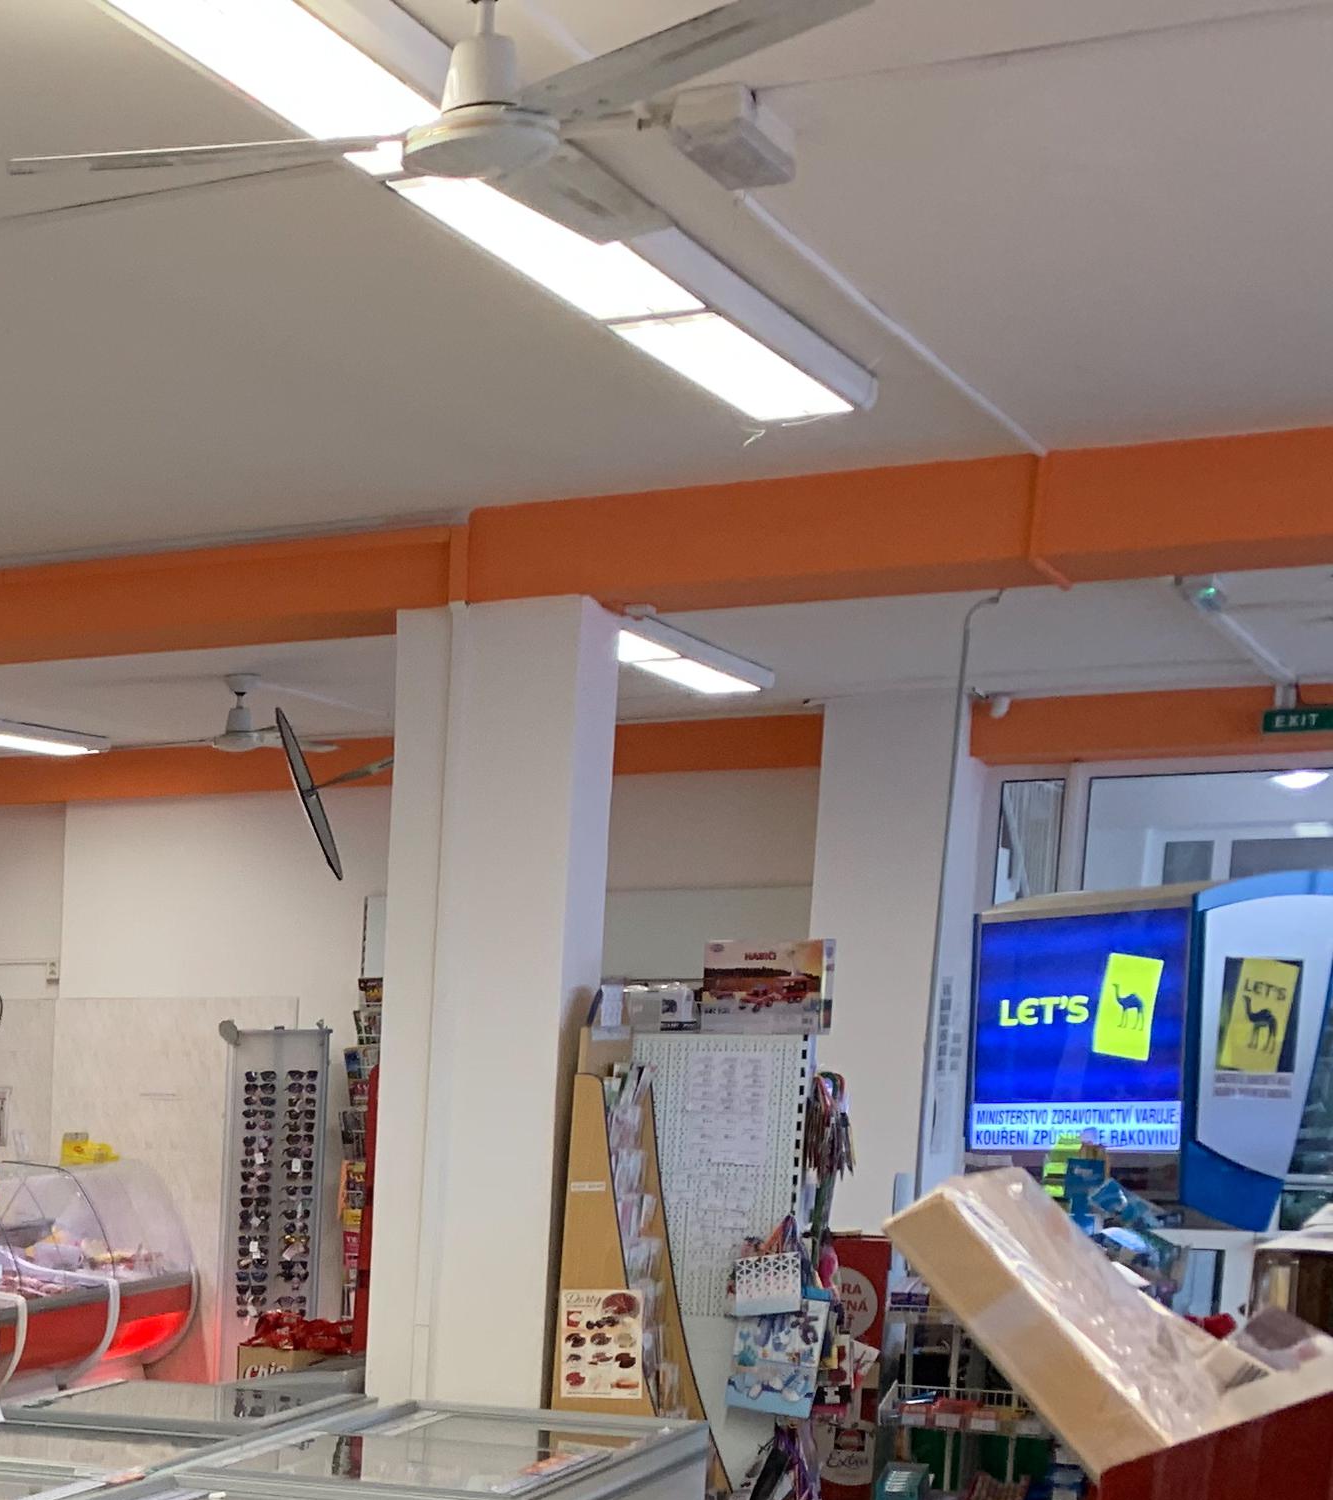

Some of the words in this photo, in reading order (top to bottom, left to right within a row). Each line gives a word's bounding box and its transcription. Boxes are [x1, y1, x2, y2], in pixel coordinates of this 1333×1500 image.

[1275, 714, 1318, 728] EXIT
[1244, 978, 1288, 1001] LET'S
[999, 995, 1089, 1026] LET'S
[976, 1110, 1048, 1125] MINISTERSTVO
[1051, 1106, 1133, 1125] ZDRAVOTNICTVÍ
[976, 1126, 1029, 1145] KOUŘENÍ
[1110, 1129, 1178, 1146] RAKOVINU
